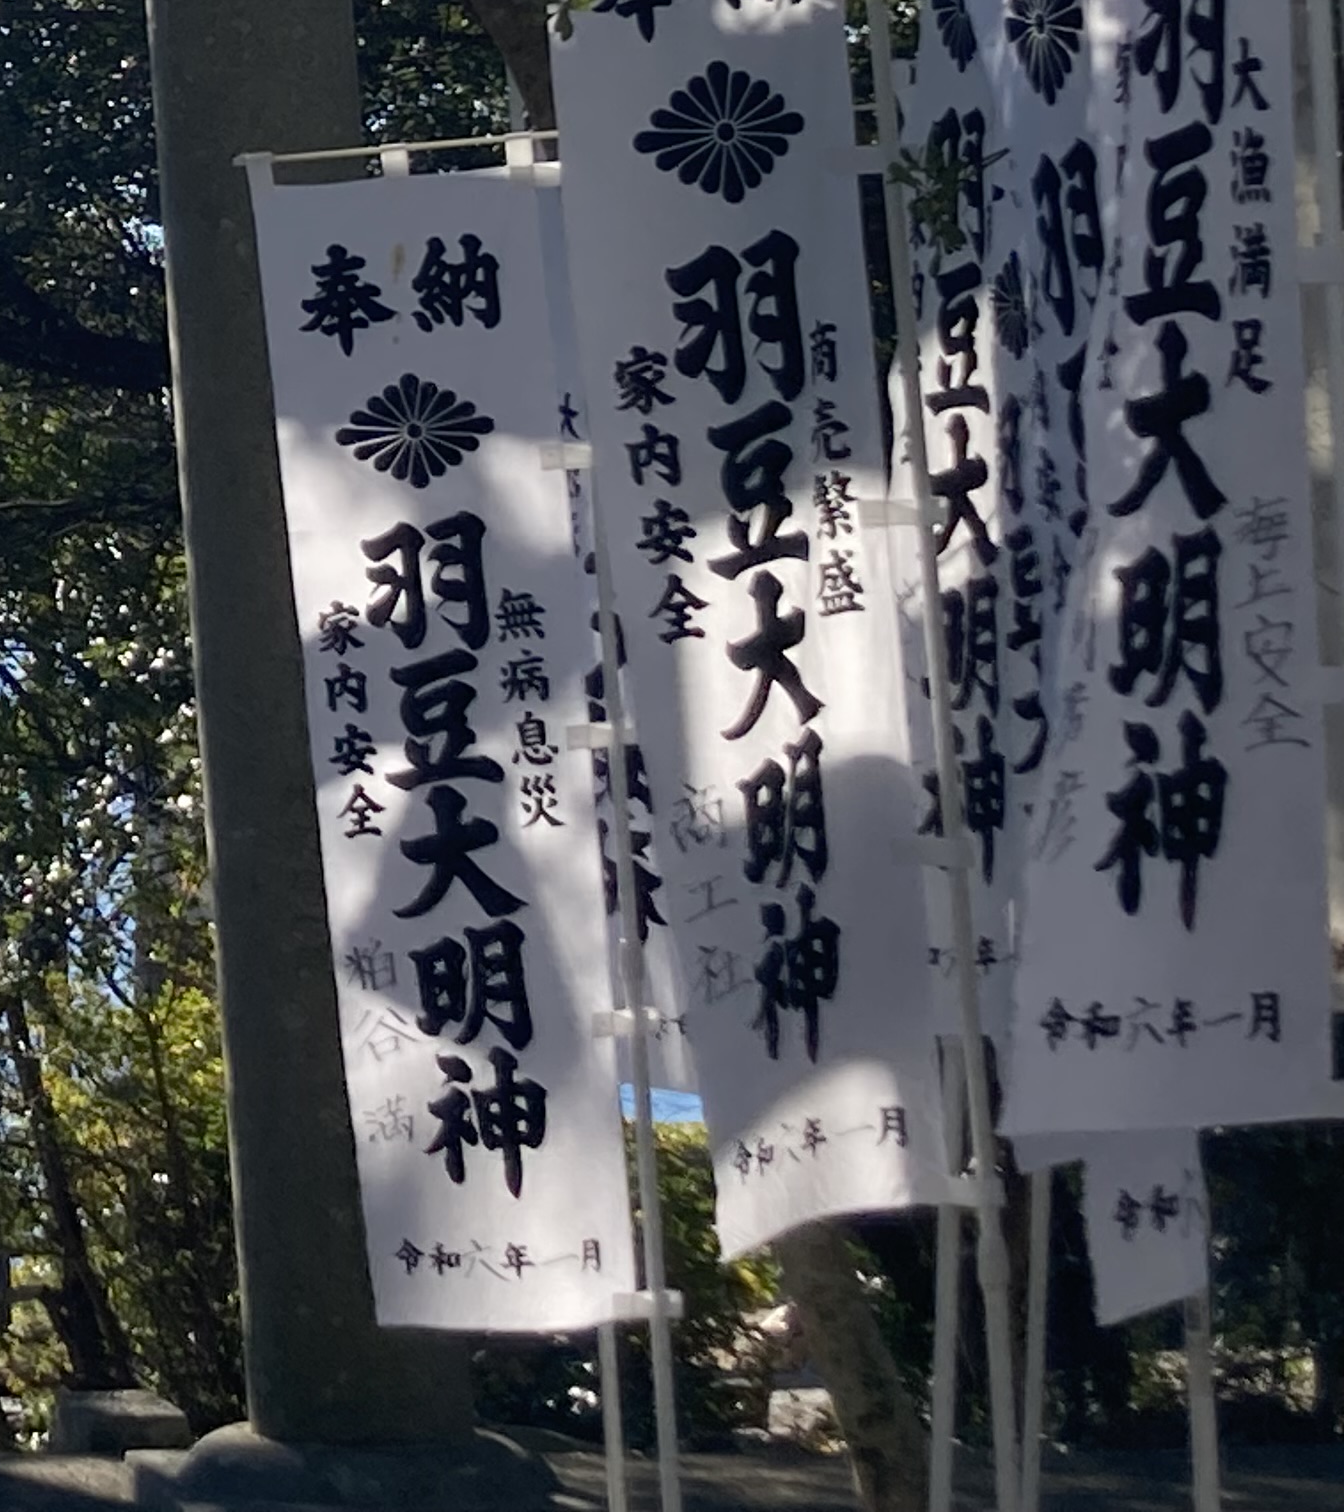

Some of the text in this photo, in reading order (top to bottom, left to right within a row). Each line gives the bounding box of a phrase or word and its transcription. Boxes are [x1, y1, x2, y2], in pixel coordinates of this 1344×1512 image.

[299, 232, 503, 358] 奉納
[1228, 36, 1275, 396] 大漁満足
[614, 345, 710, 645] 家内安全
[315, 599, 387, 839] 家内安全
[494, 587, 566, 830] 無病息災
[666, 228, 841, 1065] 羽豆大明神
[360, 509, 549, 1200] 羽豆大明神
[394, 1237, 605, 1283] 令和六年一月
